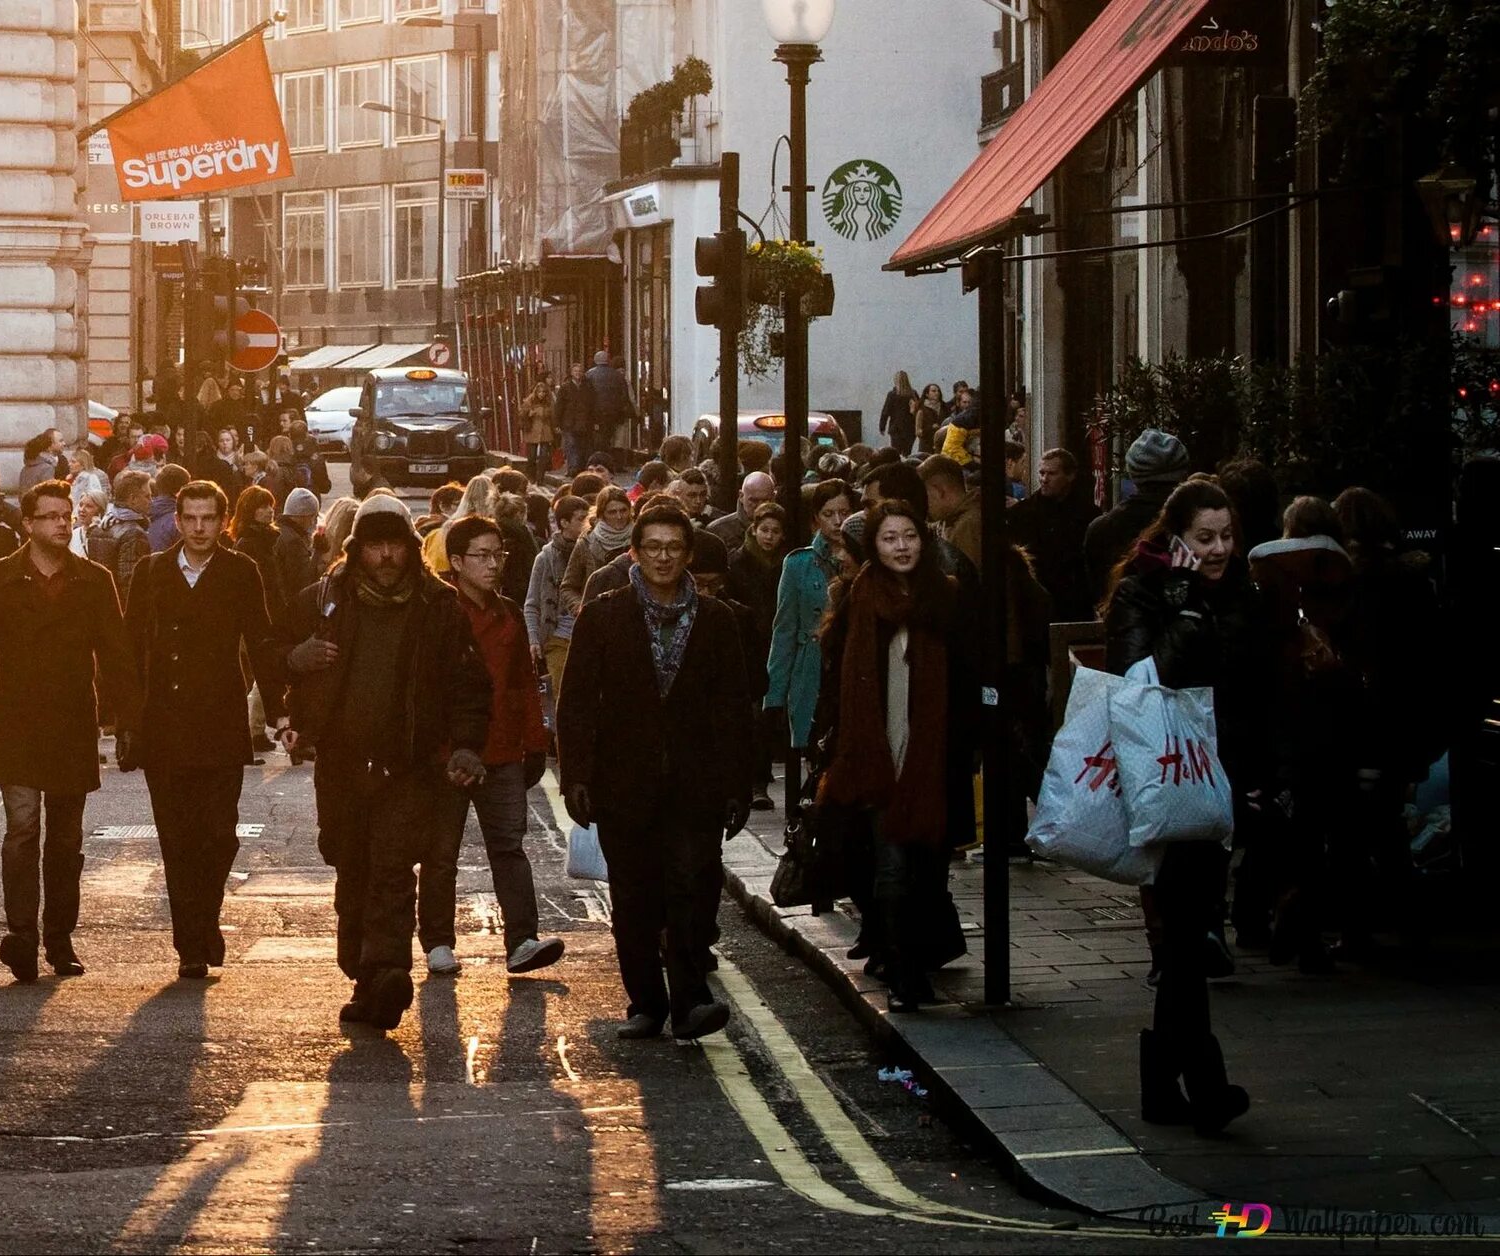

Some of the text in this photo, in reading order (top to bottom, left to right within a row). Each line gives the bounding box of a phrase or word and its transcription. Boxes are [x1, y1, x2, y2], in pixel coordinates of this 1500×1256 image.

[122, 139, 280, 190] Superdry
[150, 222, 190, 230] BROWN
[1406, 529, 1437, 539] AWAY
[1156, 733, 1216, 789] H&M
